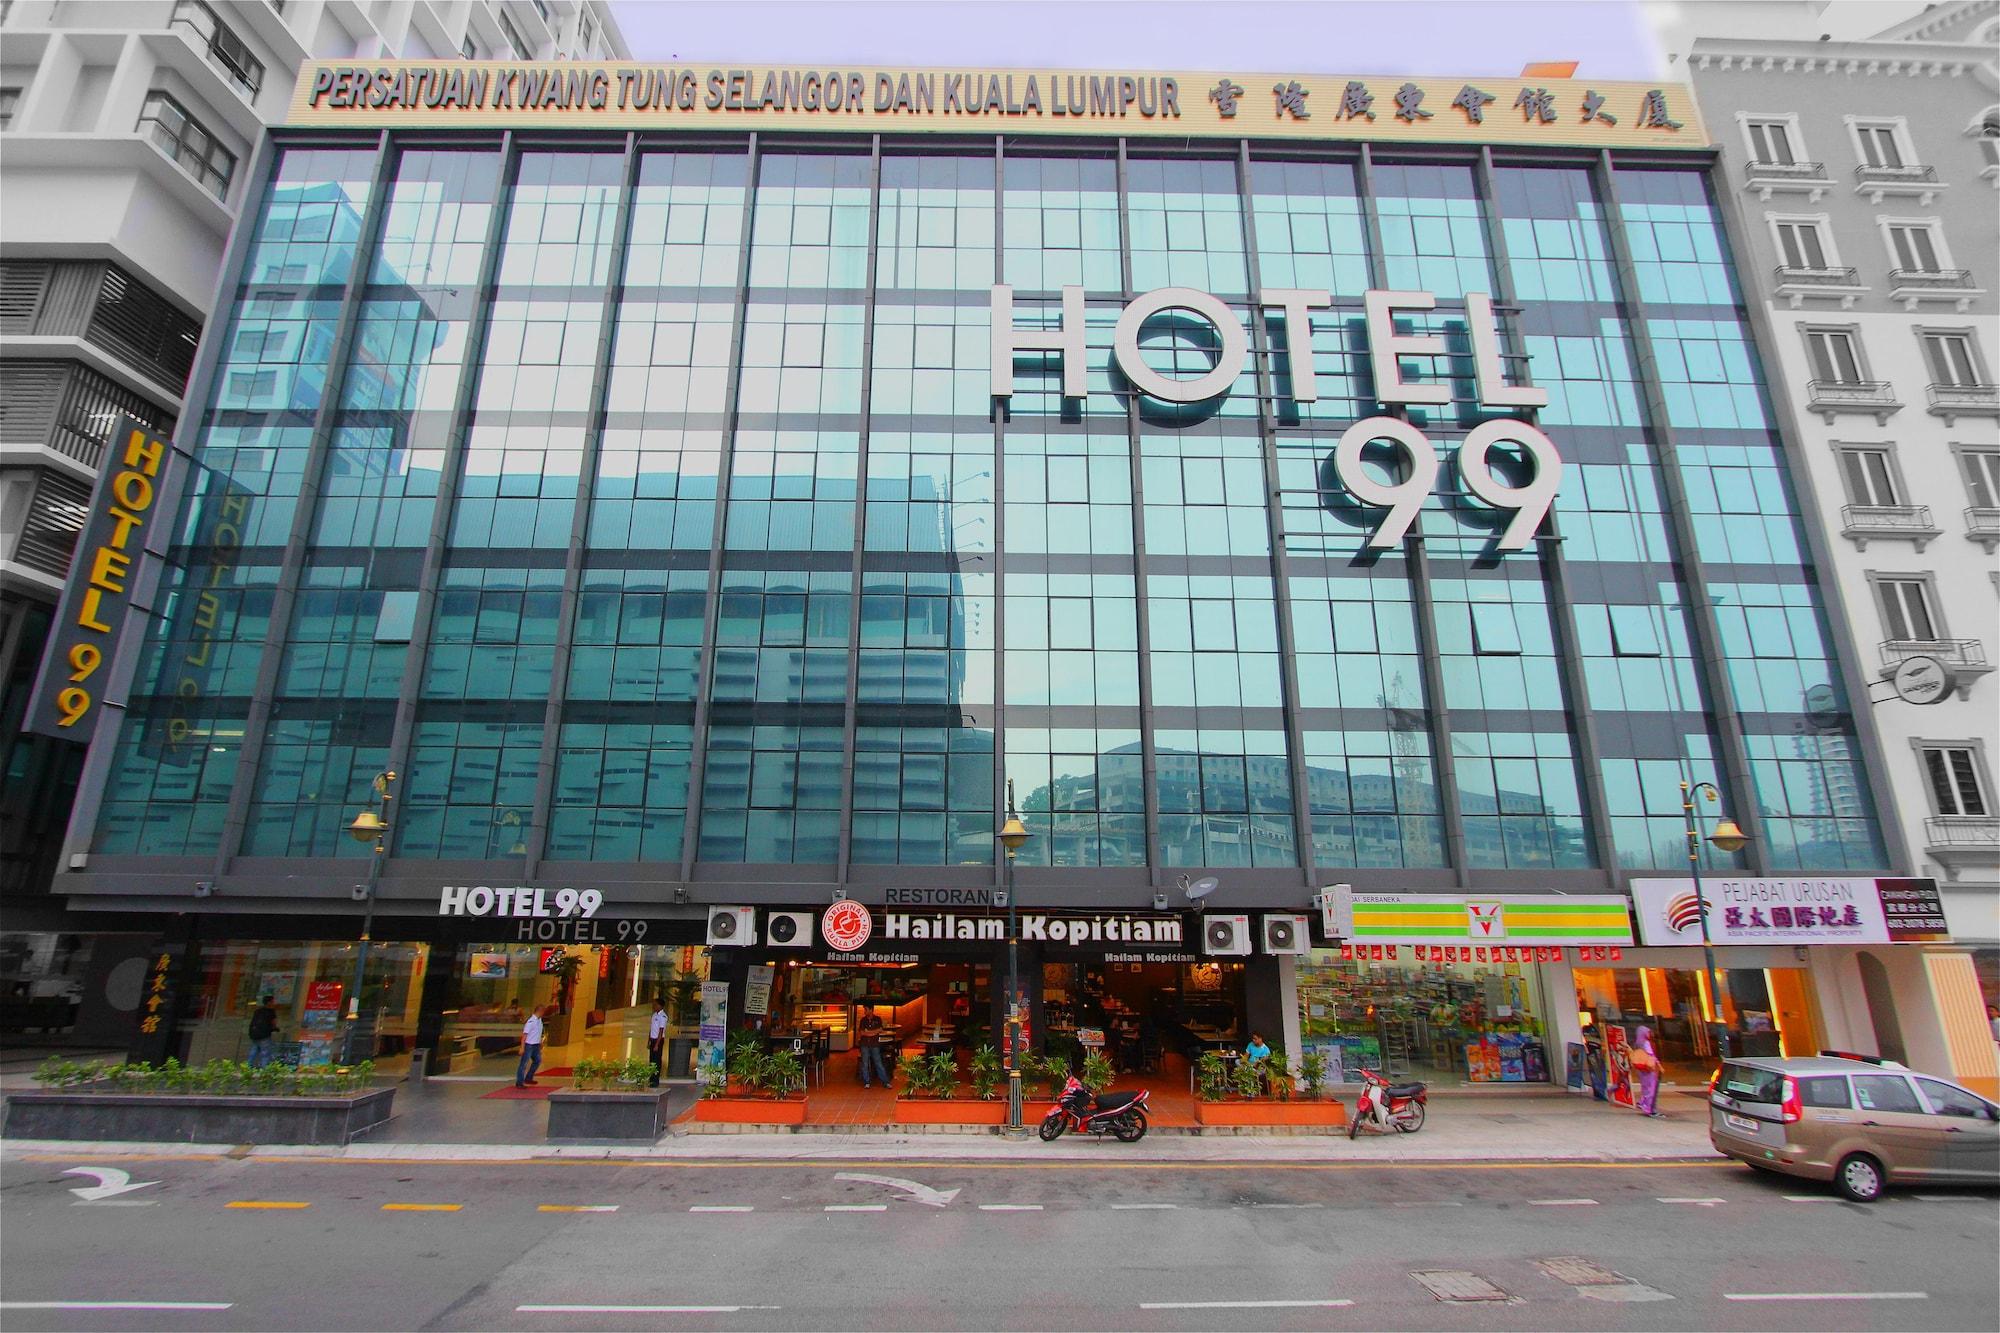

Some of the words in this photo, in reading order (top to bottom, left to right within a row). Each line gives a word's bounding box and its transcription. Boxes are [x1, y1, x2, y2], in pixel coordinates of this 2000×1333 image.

[309, 67, 488, 109] PERSATUAN
[492, 69, 608, 111] KWANG
[616, 70, 697, 111] TUNG
[703, 70, 866, 111] SELANGOR
[873, 72, 935, 113] DAN
[943, 73, 1043, 115] KUALA
[1051, 76, 1181, 118] LUMPUR
[990, 284, 1548, 408] HOTEL
[1333, 415, 1563, 551] 99
[77, 429, 164, 633] HOTEL
[57, 643, 101, 727] 99
[438, 886, 551, 917] HOTEL
[554, 887, 604, 918] 99
[885, 888, 990, 904] RESTORAN
[1722, 882, 1785, 902] PEJABAT
[1792, 882, 1853, 902] URUSAN
[827, 904, 864, 921] ORIGINAL
[517, 920, 606, 940] HOTEL
[616, 920, 648, 941] 99
[826, 929, 848, 947] KUALA
[851, 924, 869, 945] PILAH
[885, 913, 1005, 940] Hailam
[1021, 914, 1181, 945] Kopitiam
[827, 952, 865, 962] Hailam
[868, 952, 919, 963] Kopitiam
[1104, 952, 1142, 962] Hailam
[1146, 952, 1196, 964] Kopitiam
